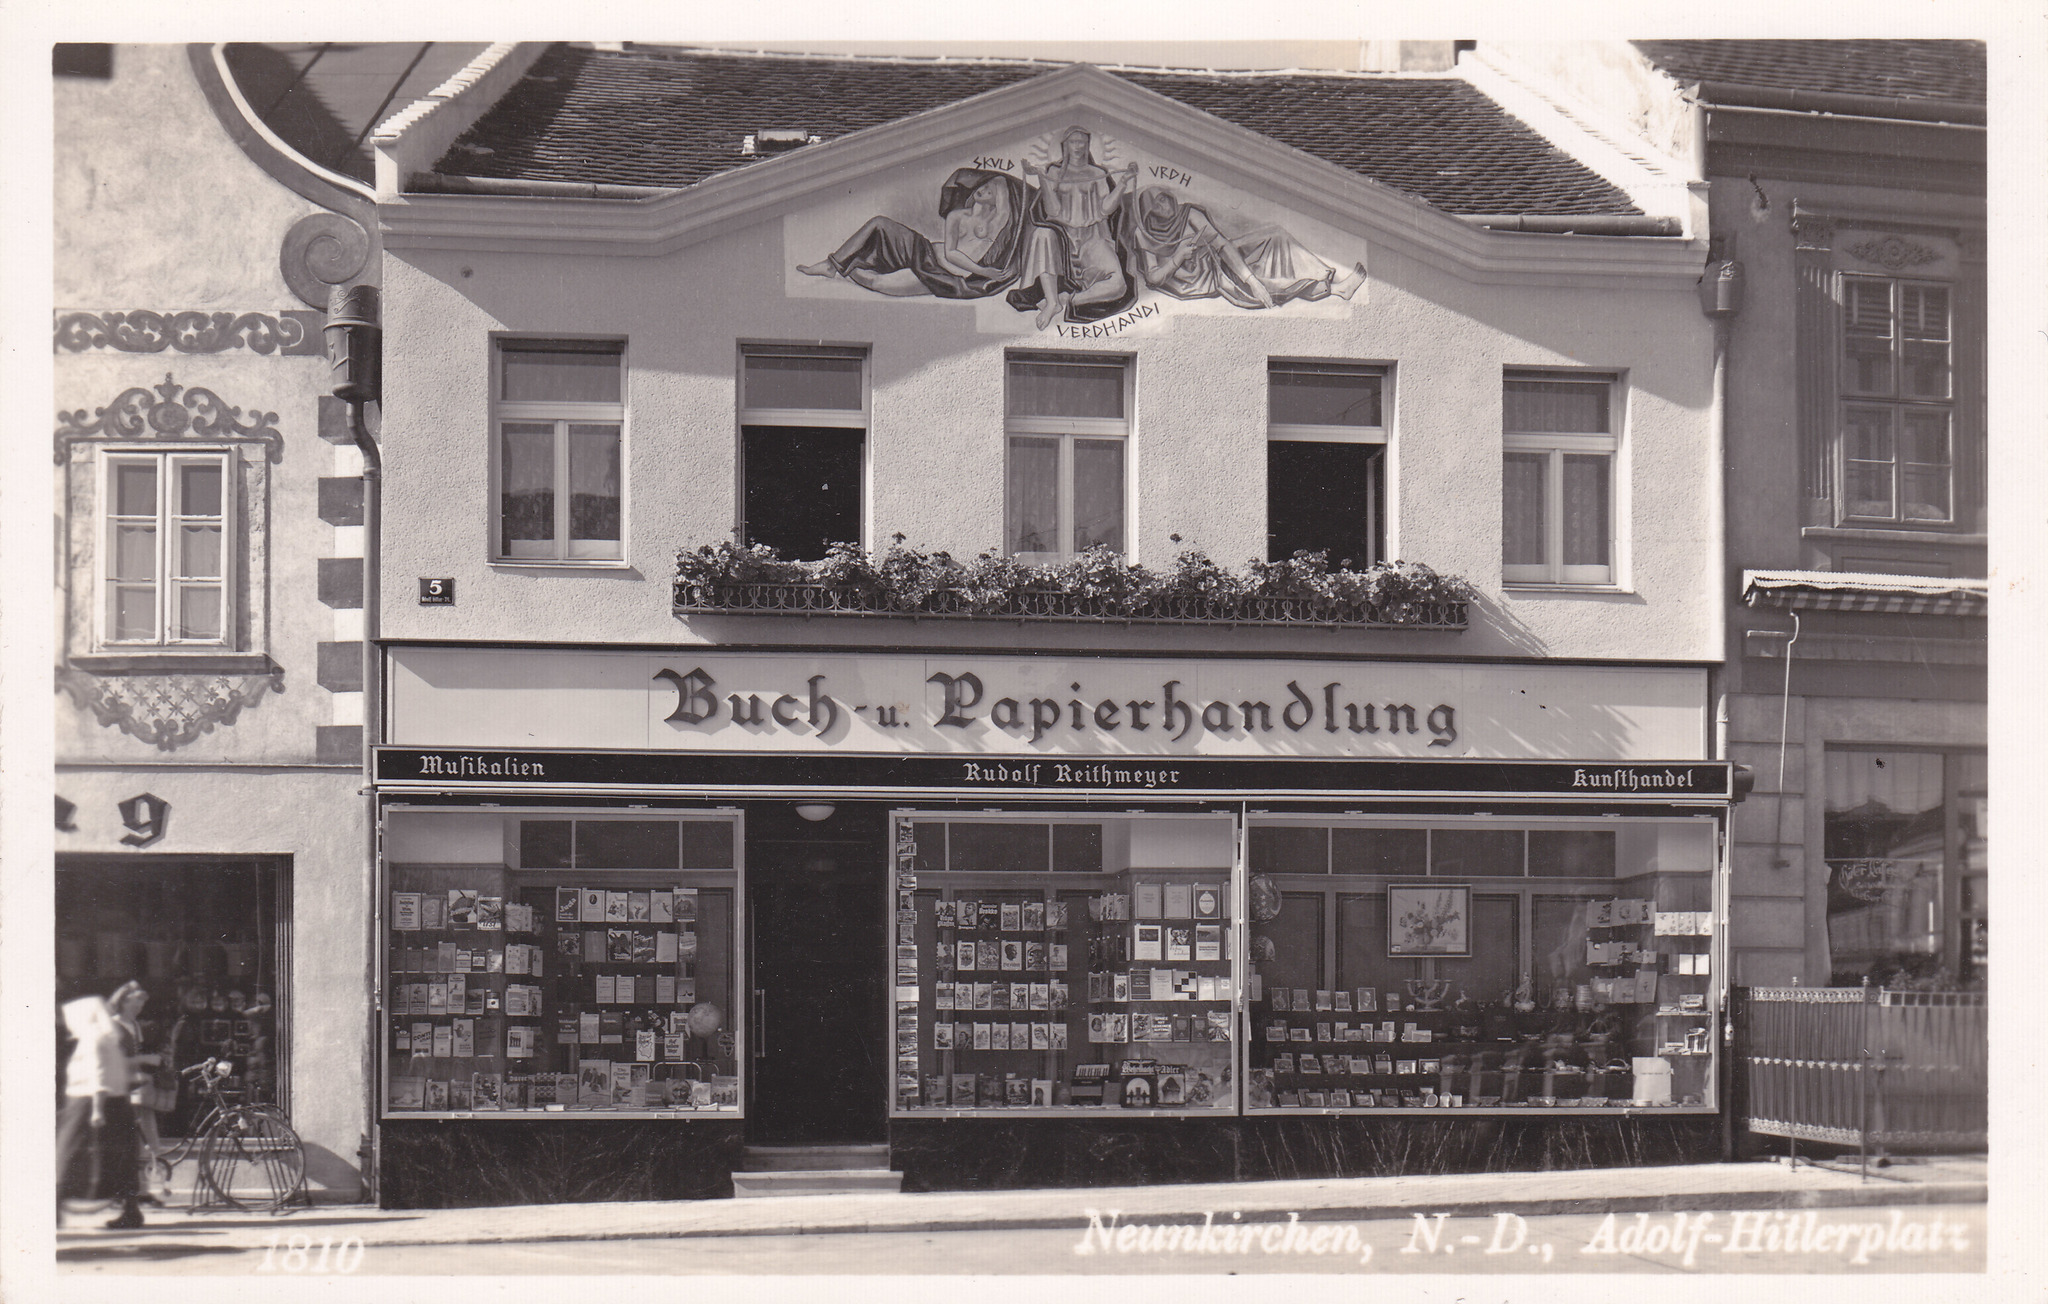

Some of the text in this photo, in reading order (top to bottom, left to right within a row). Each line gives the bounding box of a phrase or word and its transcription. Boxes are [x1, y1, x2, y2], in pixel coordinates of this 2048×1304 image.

[1056, 302, 1160, 339] VERDHANDI
[429, 580, 443, 595] 5
[927, 672, 1457, 746] Papierhandlung
[964, 762, 1181, 788] Rudolf Reithmeyer
